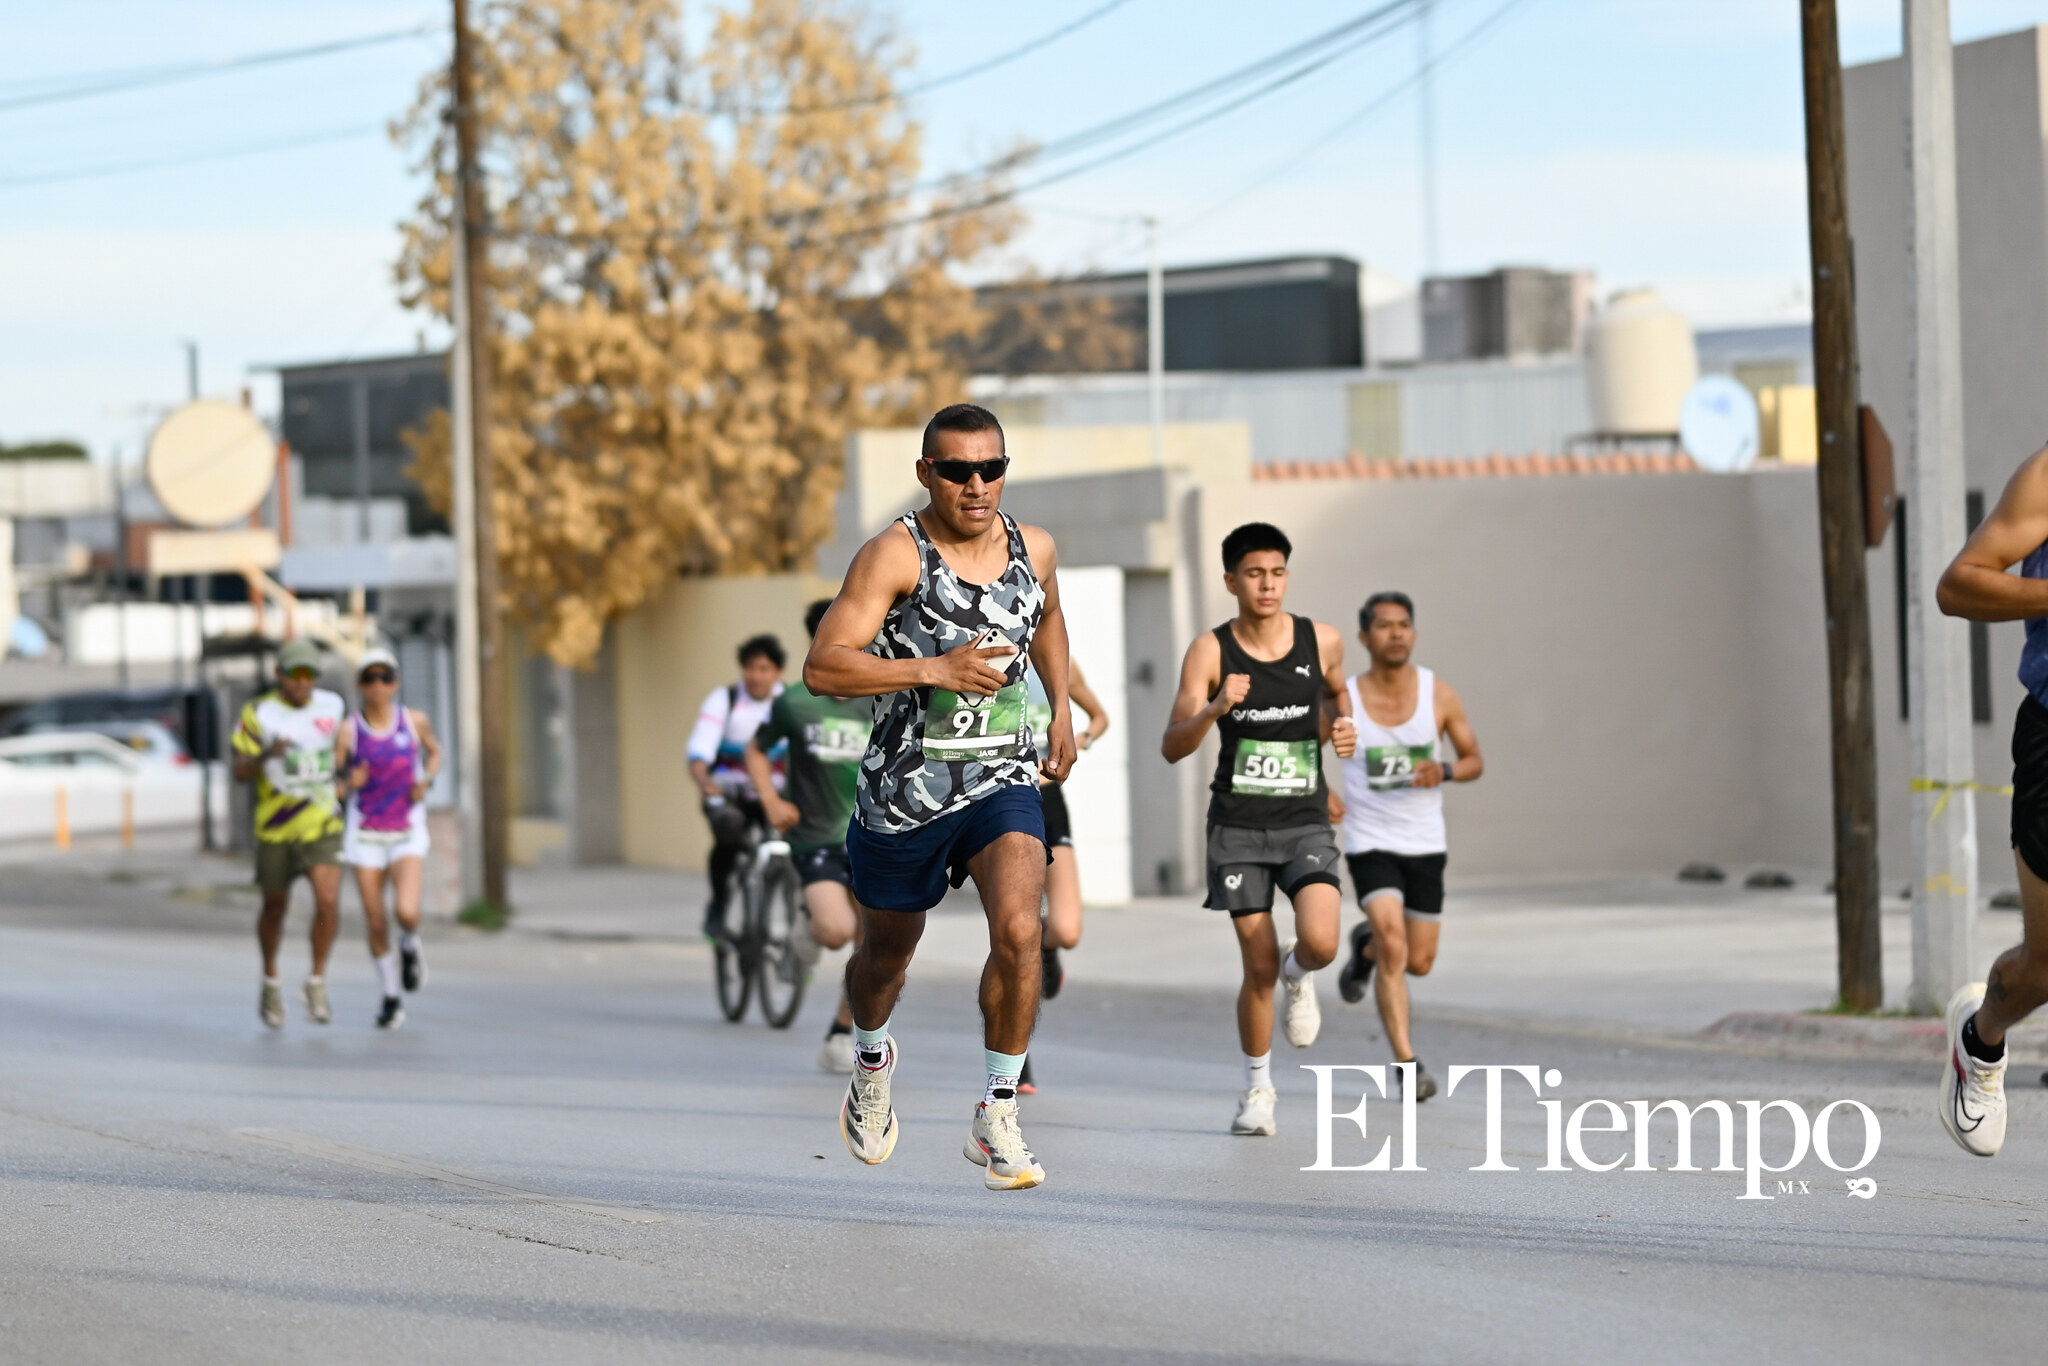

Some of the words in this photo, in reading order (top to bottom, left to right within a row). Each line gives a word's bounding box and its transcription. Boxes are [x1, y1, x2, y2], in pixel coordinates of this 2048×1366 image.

[952, 709, 991, 738] 91
[1018, 697, 1026, 745] MEDALLA
[1249, 704, 1310, 720] QualityView
[1245, 754, 1297, 779] 505
[1381, 755, 1413, 776] 73
